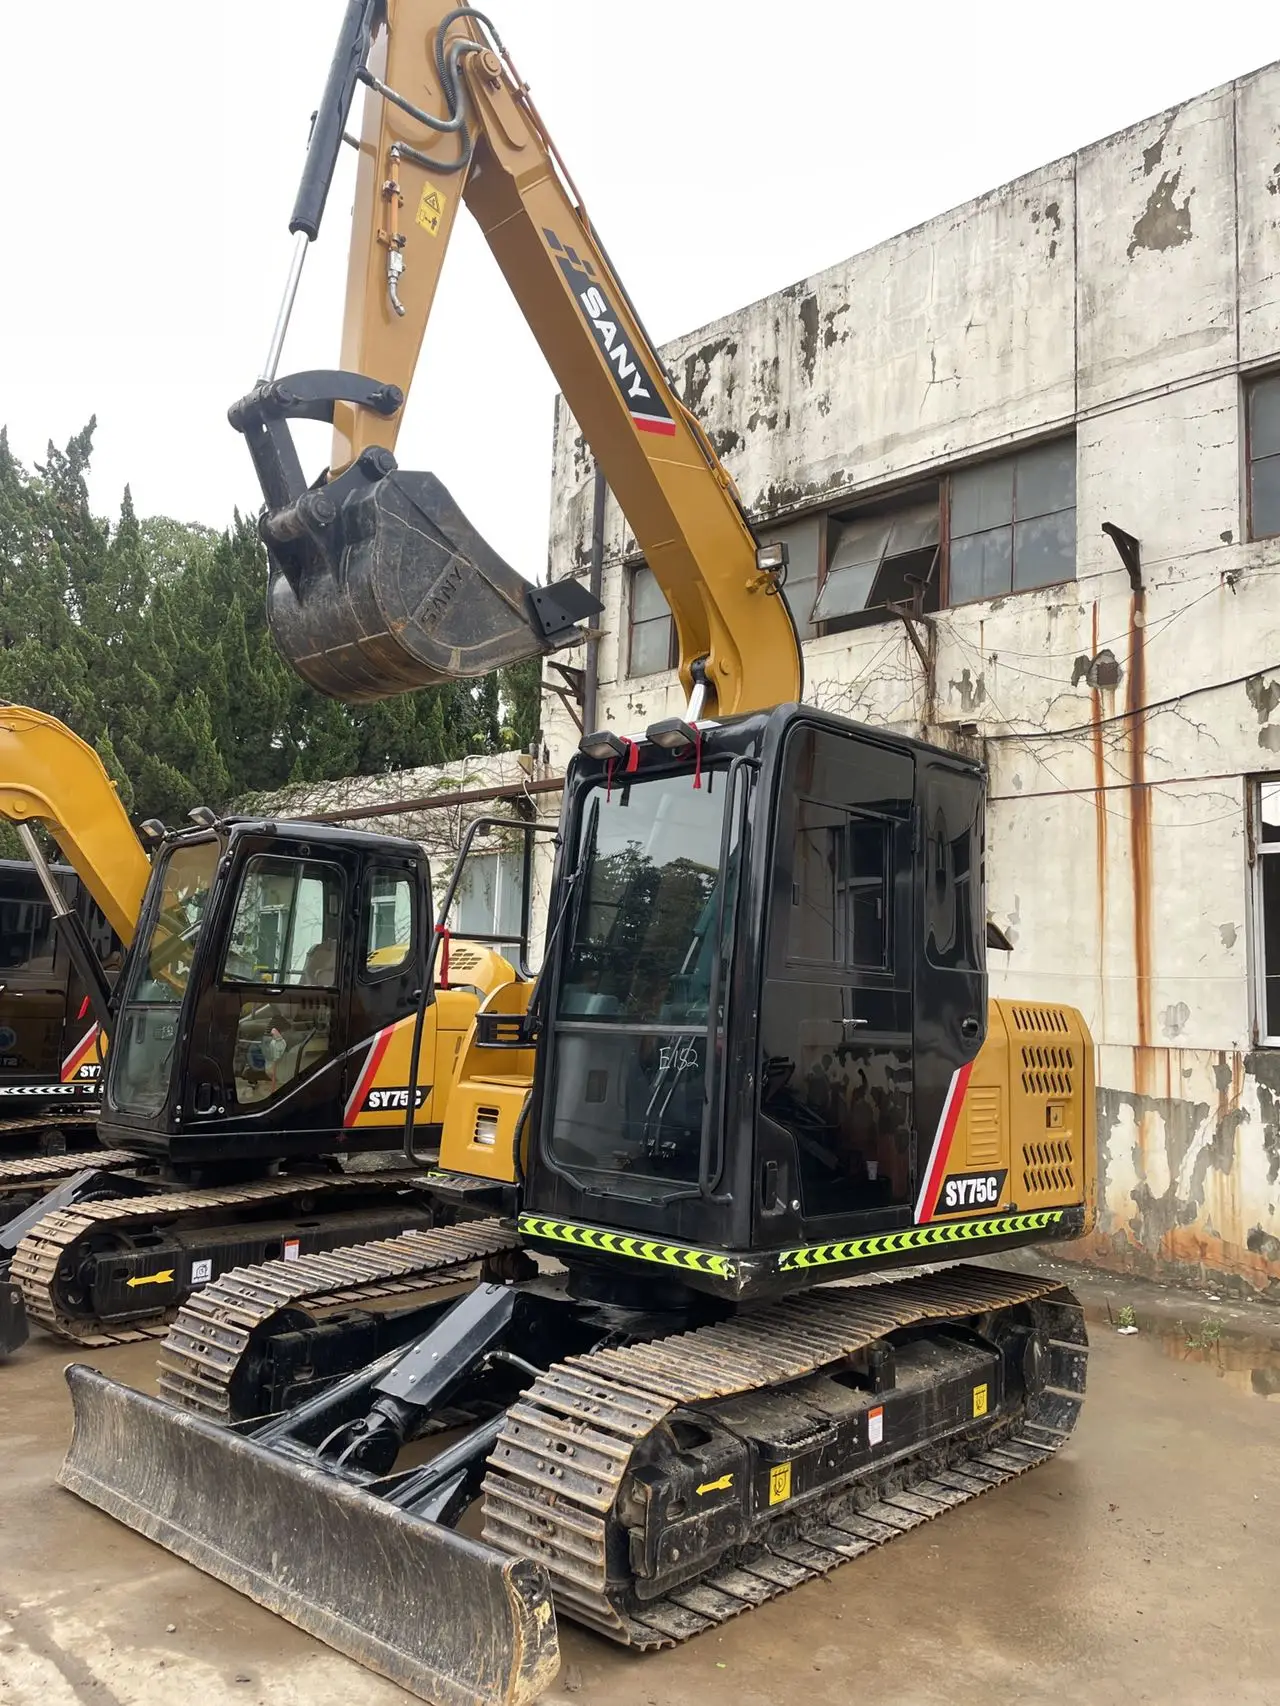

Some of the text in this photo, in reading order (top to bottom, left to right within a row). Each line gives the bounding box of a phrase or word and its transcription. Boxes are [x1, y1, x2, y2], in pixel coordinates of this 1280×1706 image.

[580, 286, 651, 399] SANY
[418, 565, 463, 624] SANY
[945, 1176, 998, 1207] SY75C
